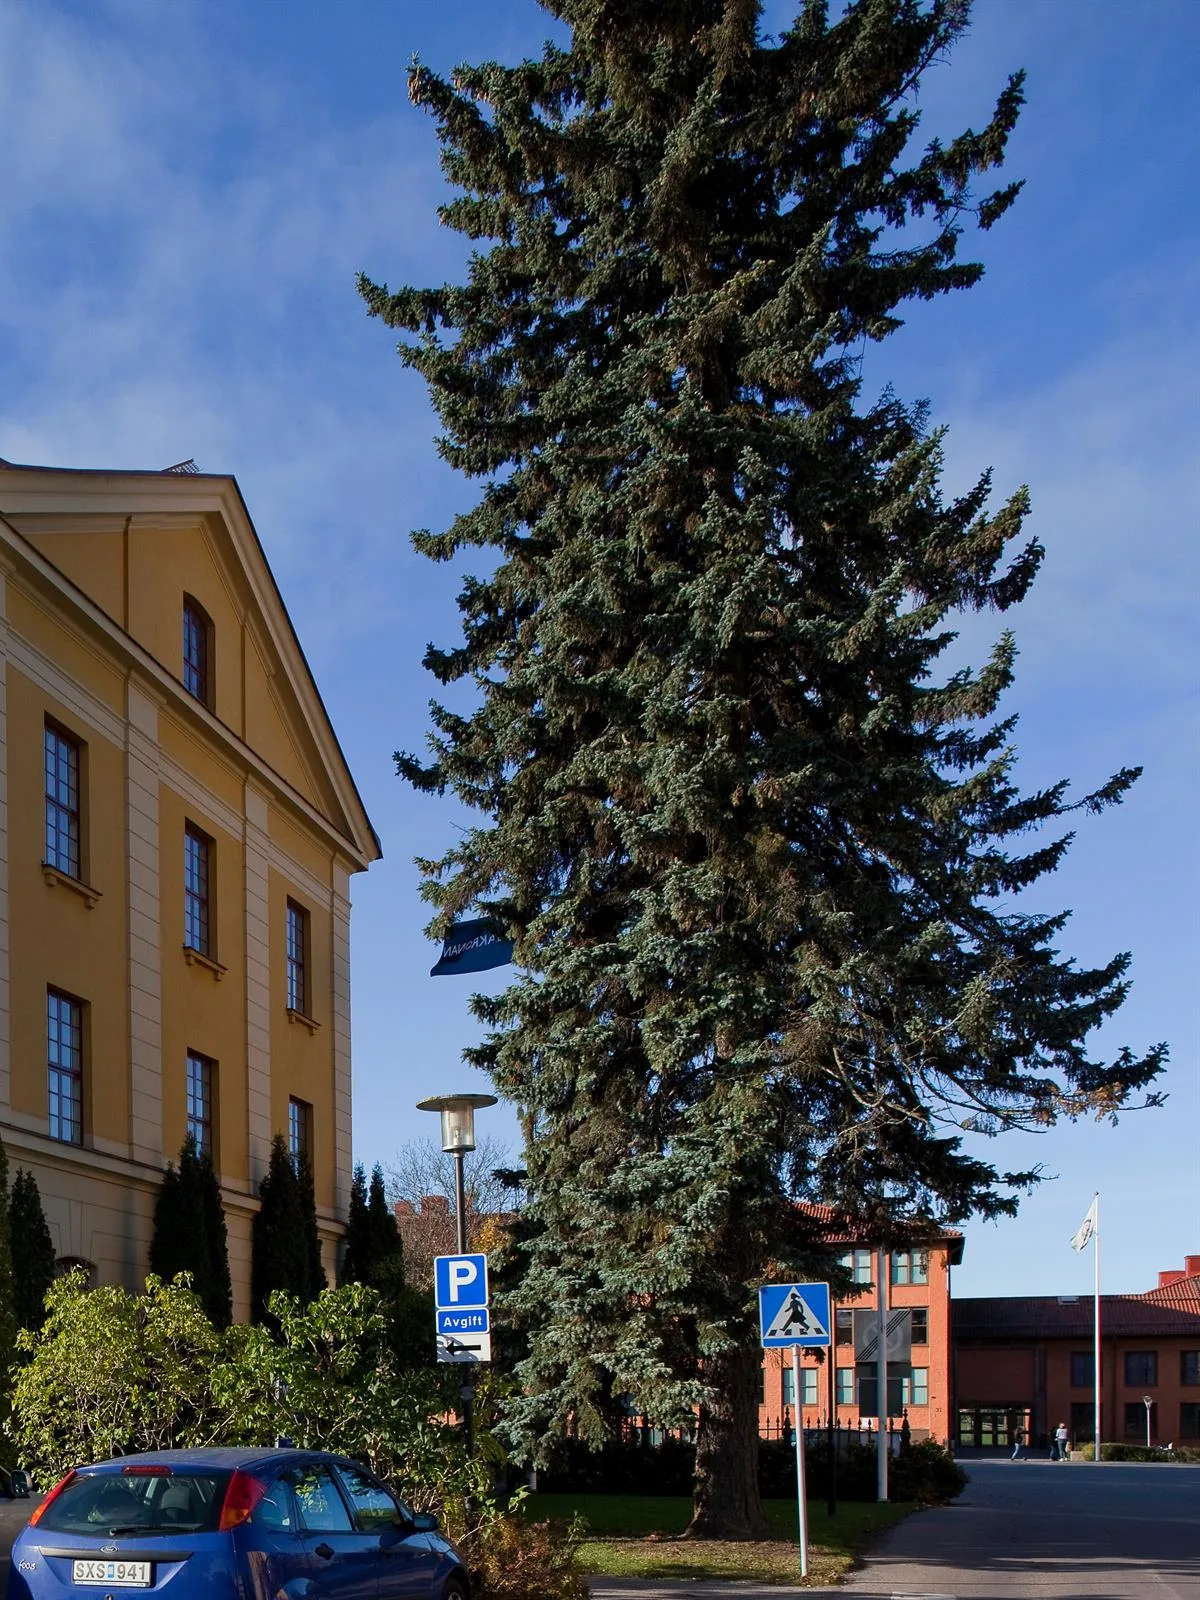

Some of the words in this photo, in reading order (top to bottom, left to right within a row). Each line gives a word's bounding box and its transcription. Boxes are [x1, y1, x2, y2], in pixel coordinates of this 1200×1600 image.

[449, 1260, 477, 1302] P
[443, 1315, 482, 1329] Avgift
[75, 1562, 106, 1579] SXS
[117, 1563, 146, 1580] 941
